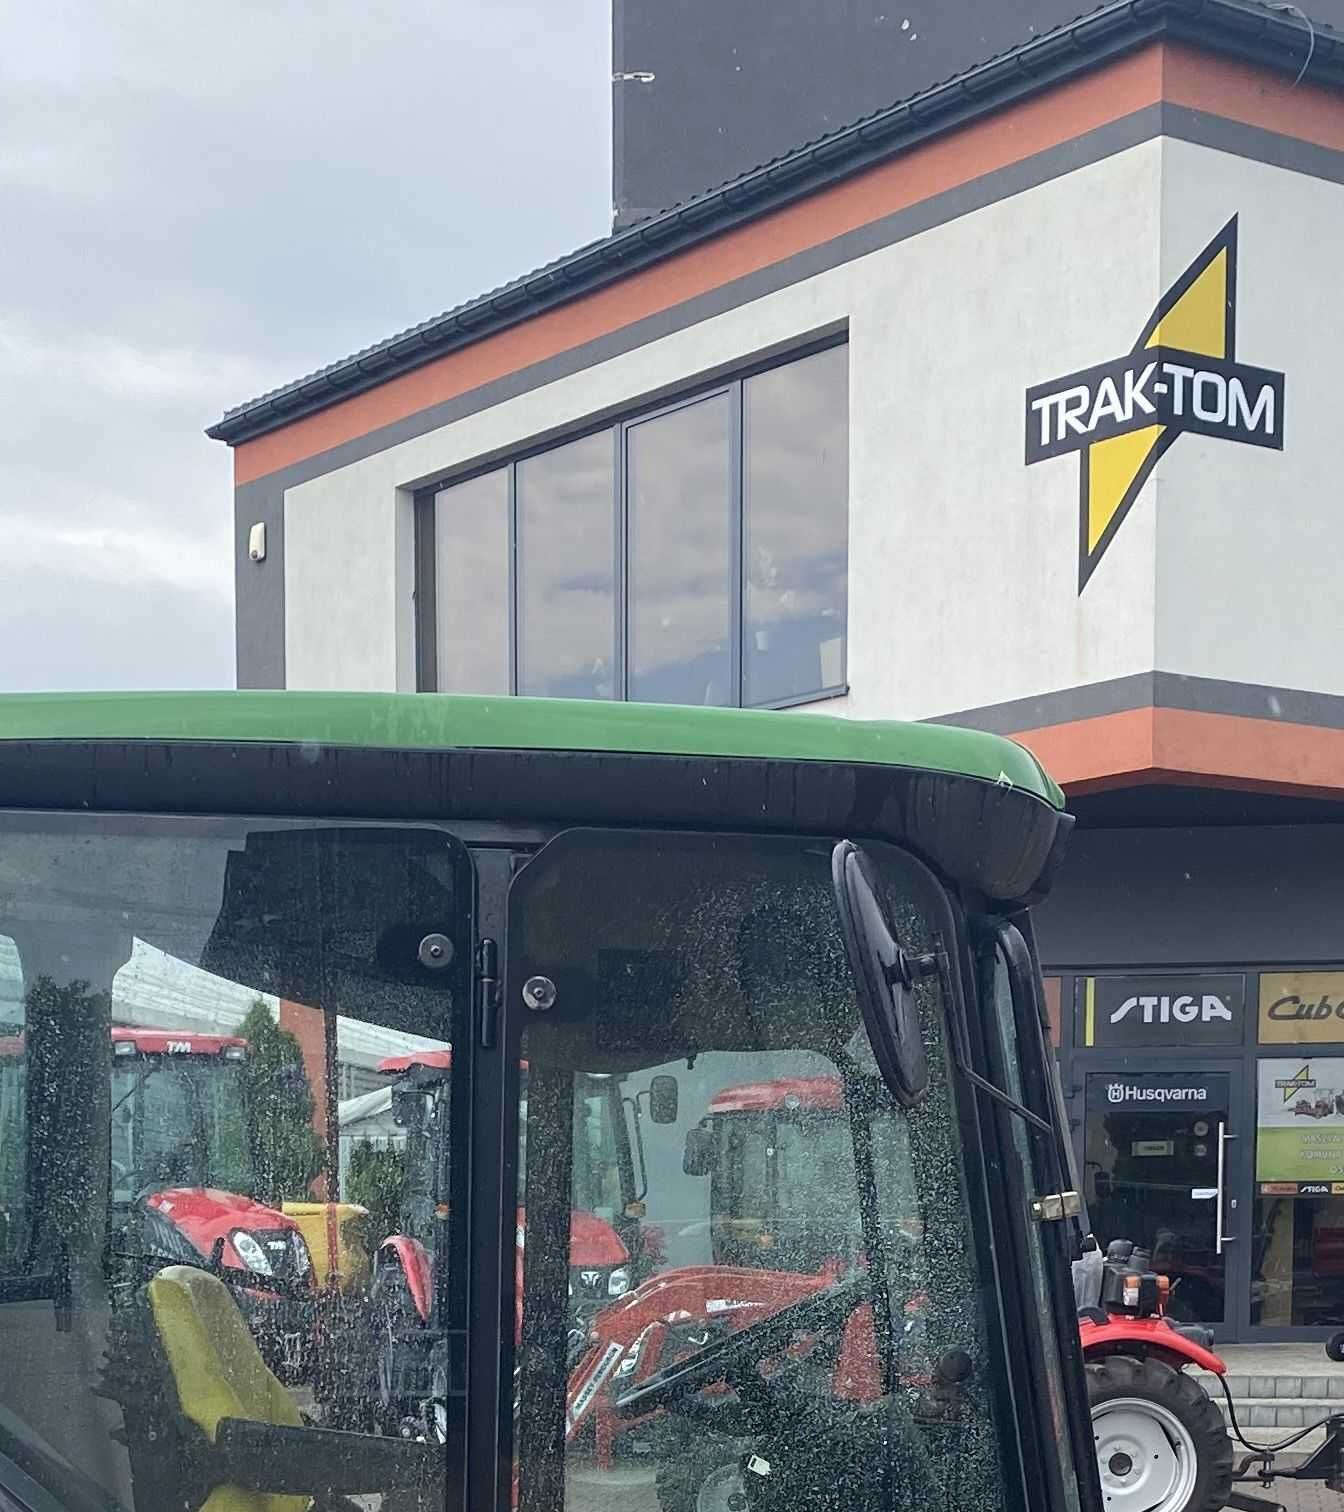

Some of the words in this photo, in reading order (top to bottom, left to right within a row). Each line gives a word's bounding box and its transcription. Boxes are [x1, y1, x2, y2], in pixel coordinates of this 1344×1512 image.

[1031, 361, 1275, 447] TRAK-TOM
[1110, 995, 1232, 1024] STIGA
[1267, 995, 1333, 1020] Cub
[1125, 1085, 1207, 1103] Husqvarna
[1300, 1185, 1329, 1194] STIGA
